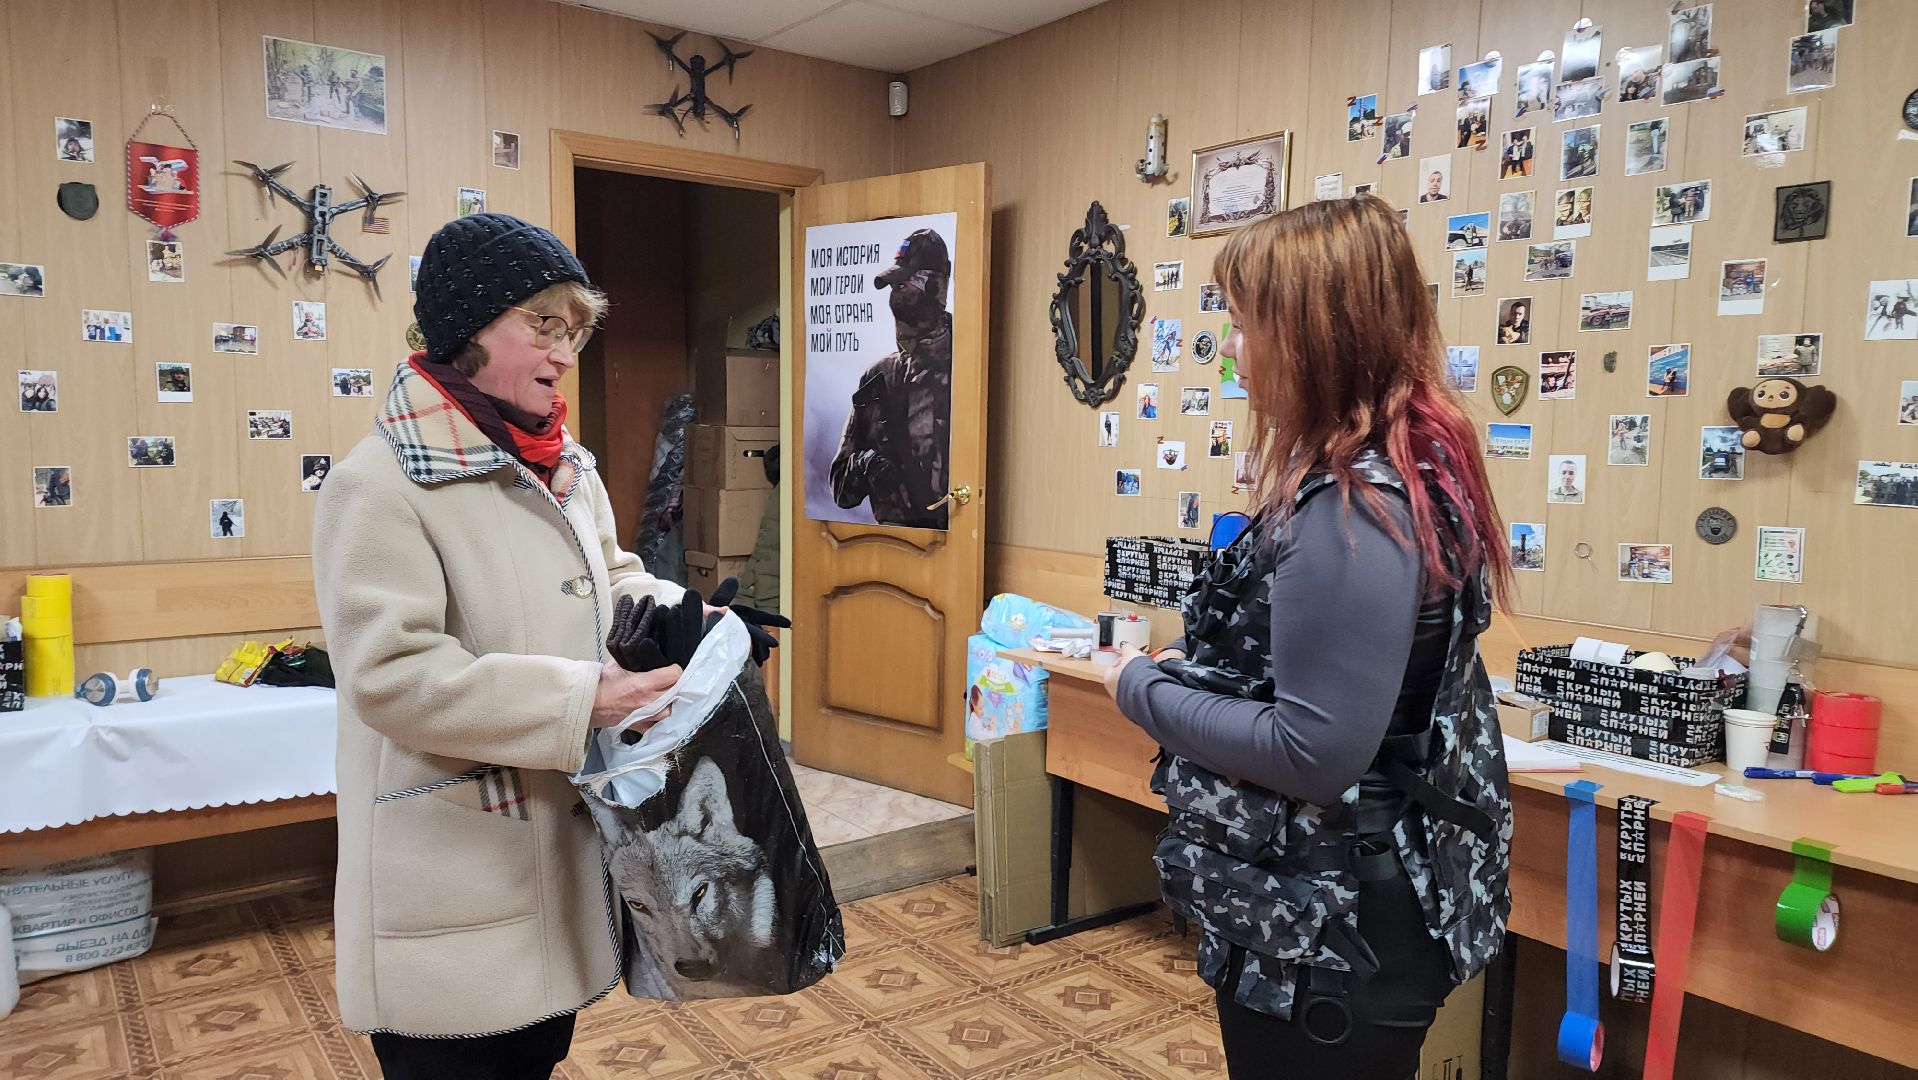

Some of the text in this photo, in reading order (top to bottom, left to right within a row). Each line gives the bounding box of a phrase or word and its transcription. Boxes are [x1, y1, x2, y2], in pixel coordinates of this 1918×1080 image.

[811, 244, 880, 268] МОЯ ИСТОРИЯ
[810, 274, 864, 296] МОИ ГЕРОИ
[810, 303, 873, 324] МОЯ СТРАНА
[810, 328, 859, 352] МОЙ ПУТЬ
[1610, 711, 1668, 728] КРУТЫХ
[1576, 726, 1632, 746] КРУТЫХ
[13, 918, 76, 935] КВАРТИР
[89, 906, 138, 924] ОФИСОВ
[1620, 880, 1632, 944] КРУТЫХ
[56, 938, 107, 952] ВЫЕЗД
[111, 932, 129, 944] НА
[76, 950, 100, 962] 800
